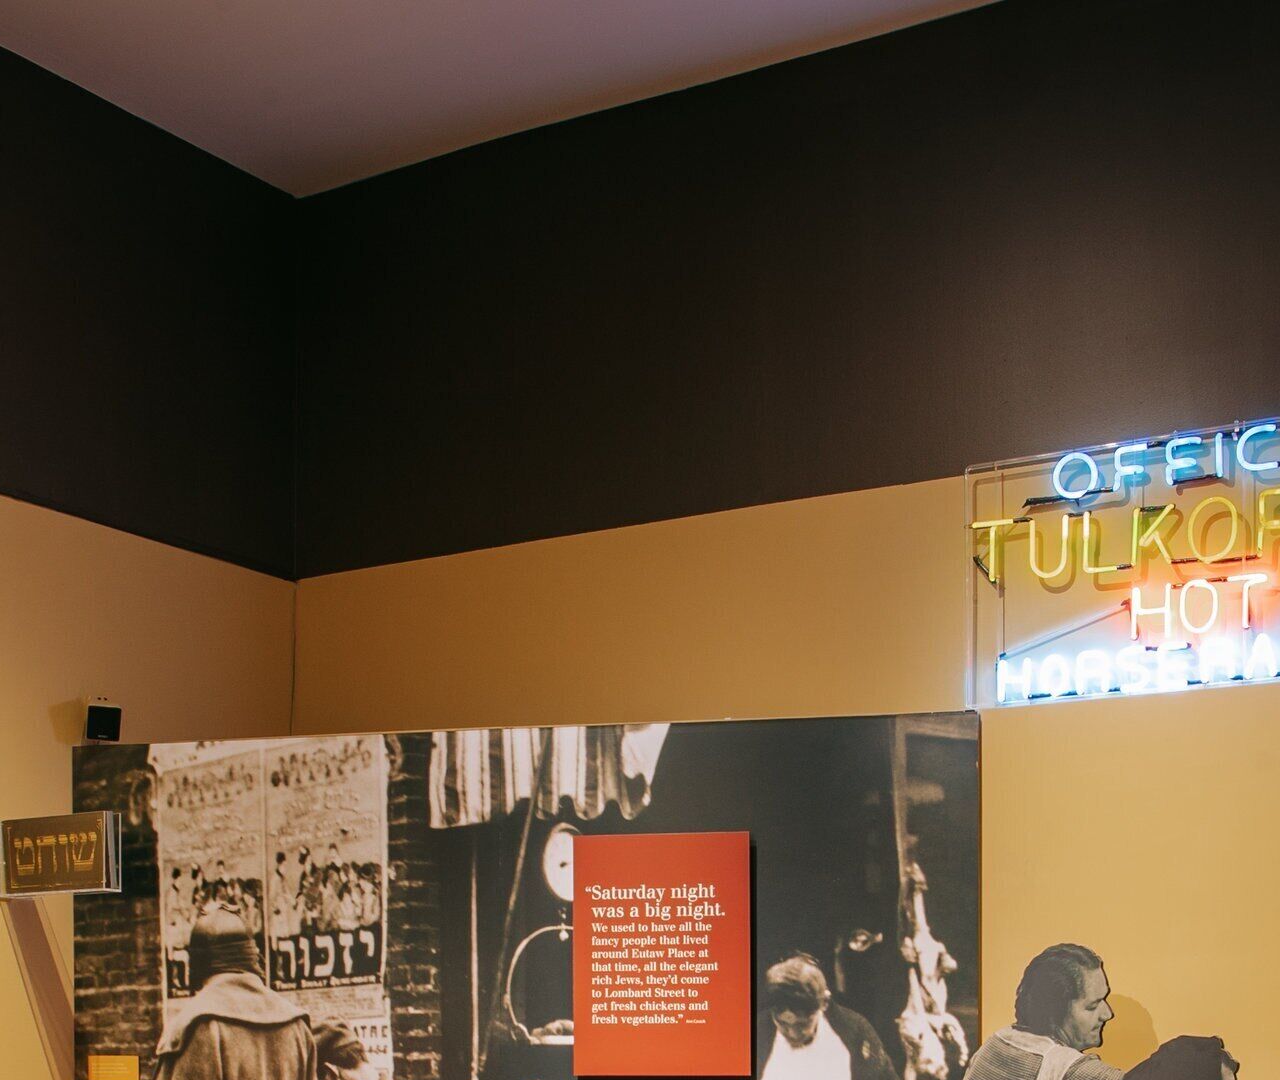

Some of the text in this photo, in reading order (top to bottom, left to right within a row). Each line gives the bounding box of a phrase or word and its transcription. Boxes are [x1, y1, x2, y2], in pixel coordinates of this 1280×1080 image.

[1129, 572, 1268, 641] HOT
[671, 883, 716, 902] night
[591, 901, 725, 921] was a big night.
[591, 921, 712, 933] We used to have all the
[591, 934, 708, 948] fancy people that lived
